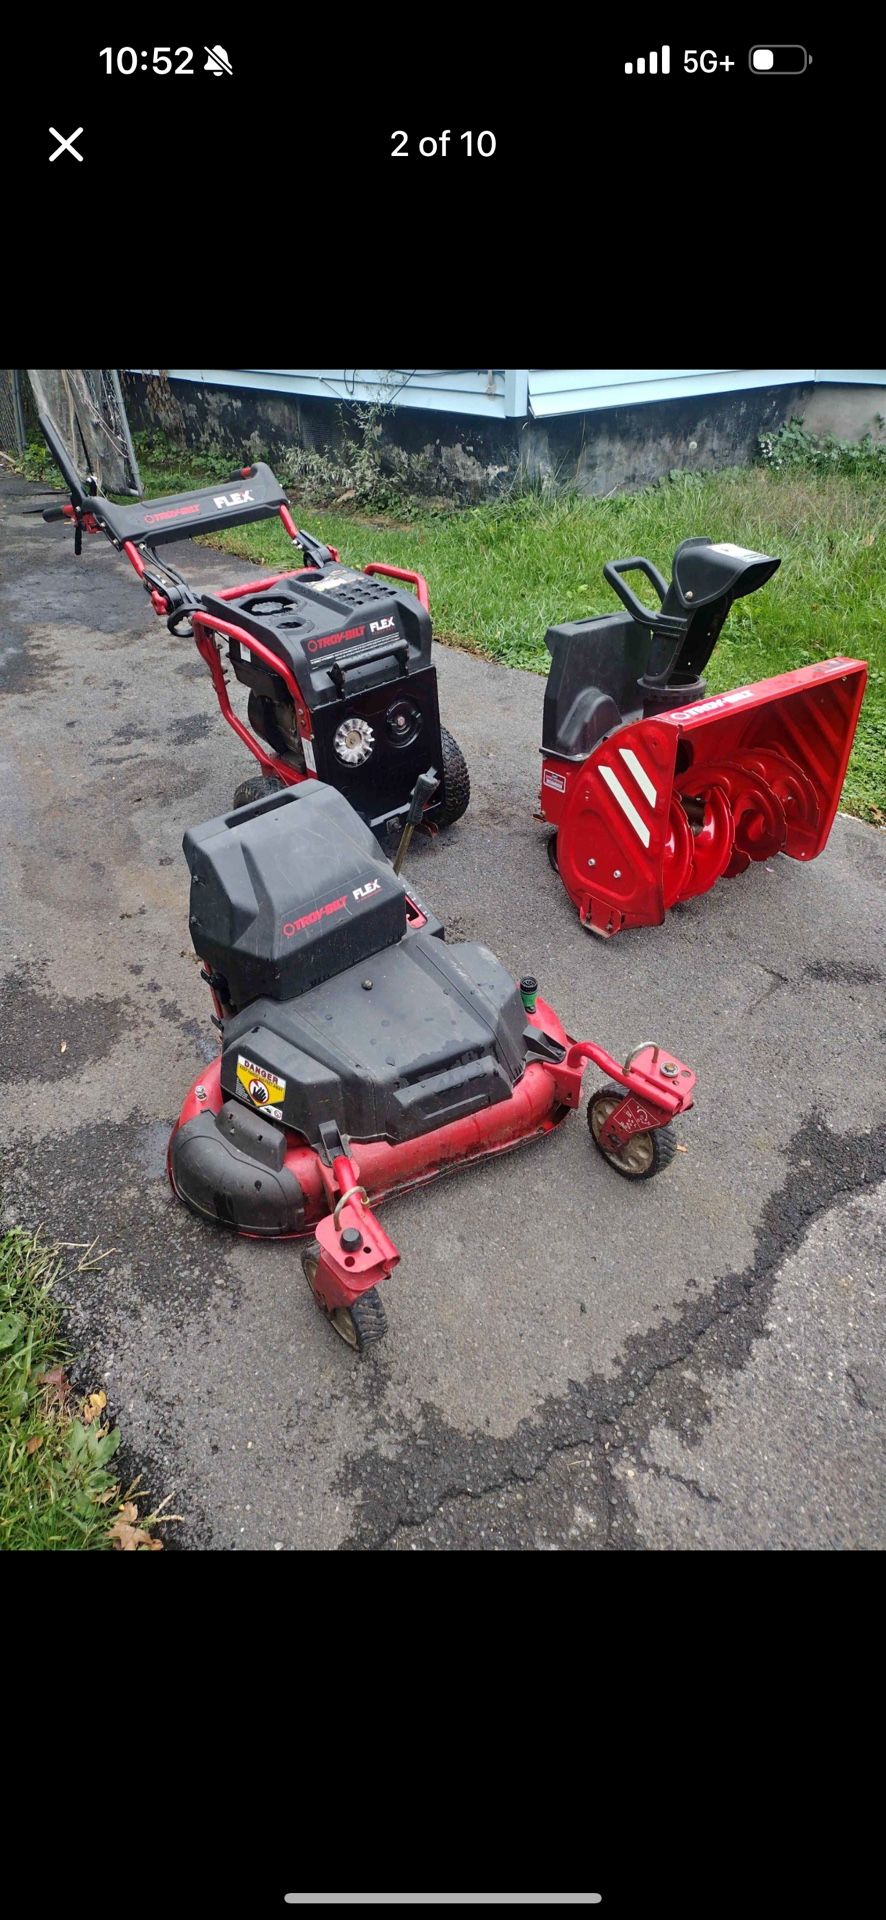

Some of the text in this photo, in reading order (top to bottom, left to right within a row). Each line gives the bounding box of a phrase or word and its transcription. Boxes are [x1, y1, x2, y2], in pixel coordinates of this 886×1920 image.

[213, 490, 254, 509] FLEX
[317, 624, 366, 649] TROY-BILT
[369, 616, 395, 633] FLEX
[294, 895, 348, 930] TROY-BILT
[352, 879, 381, 900] FLEX
[244, 1060, 279, 1085] DANGER
